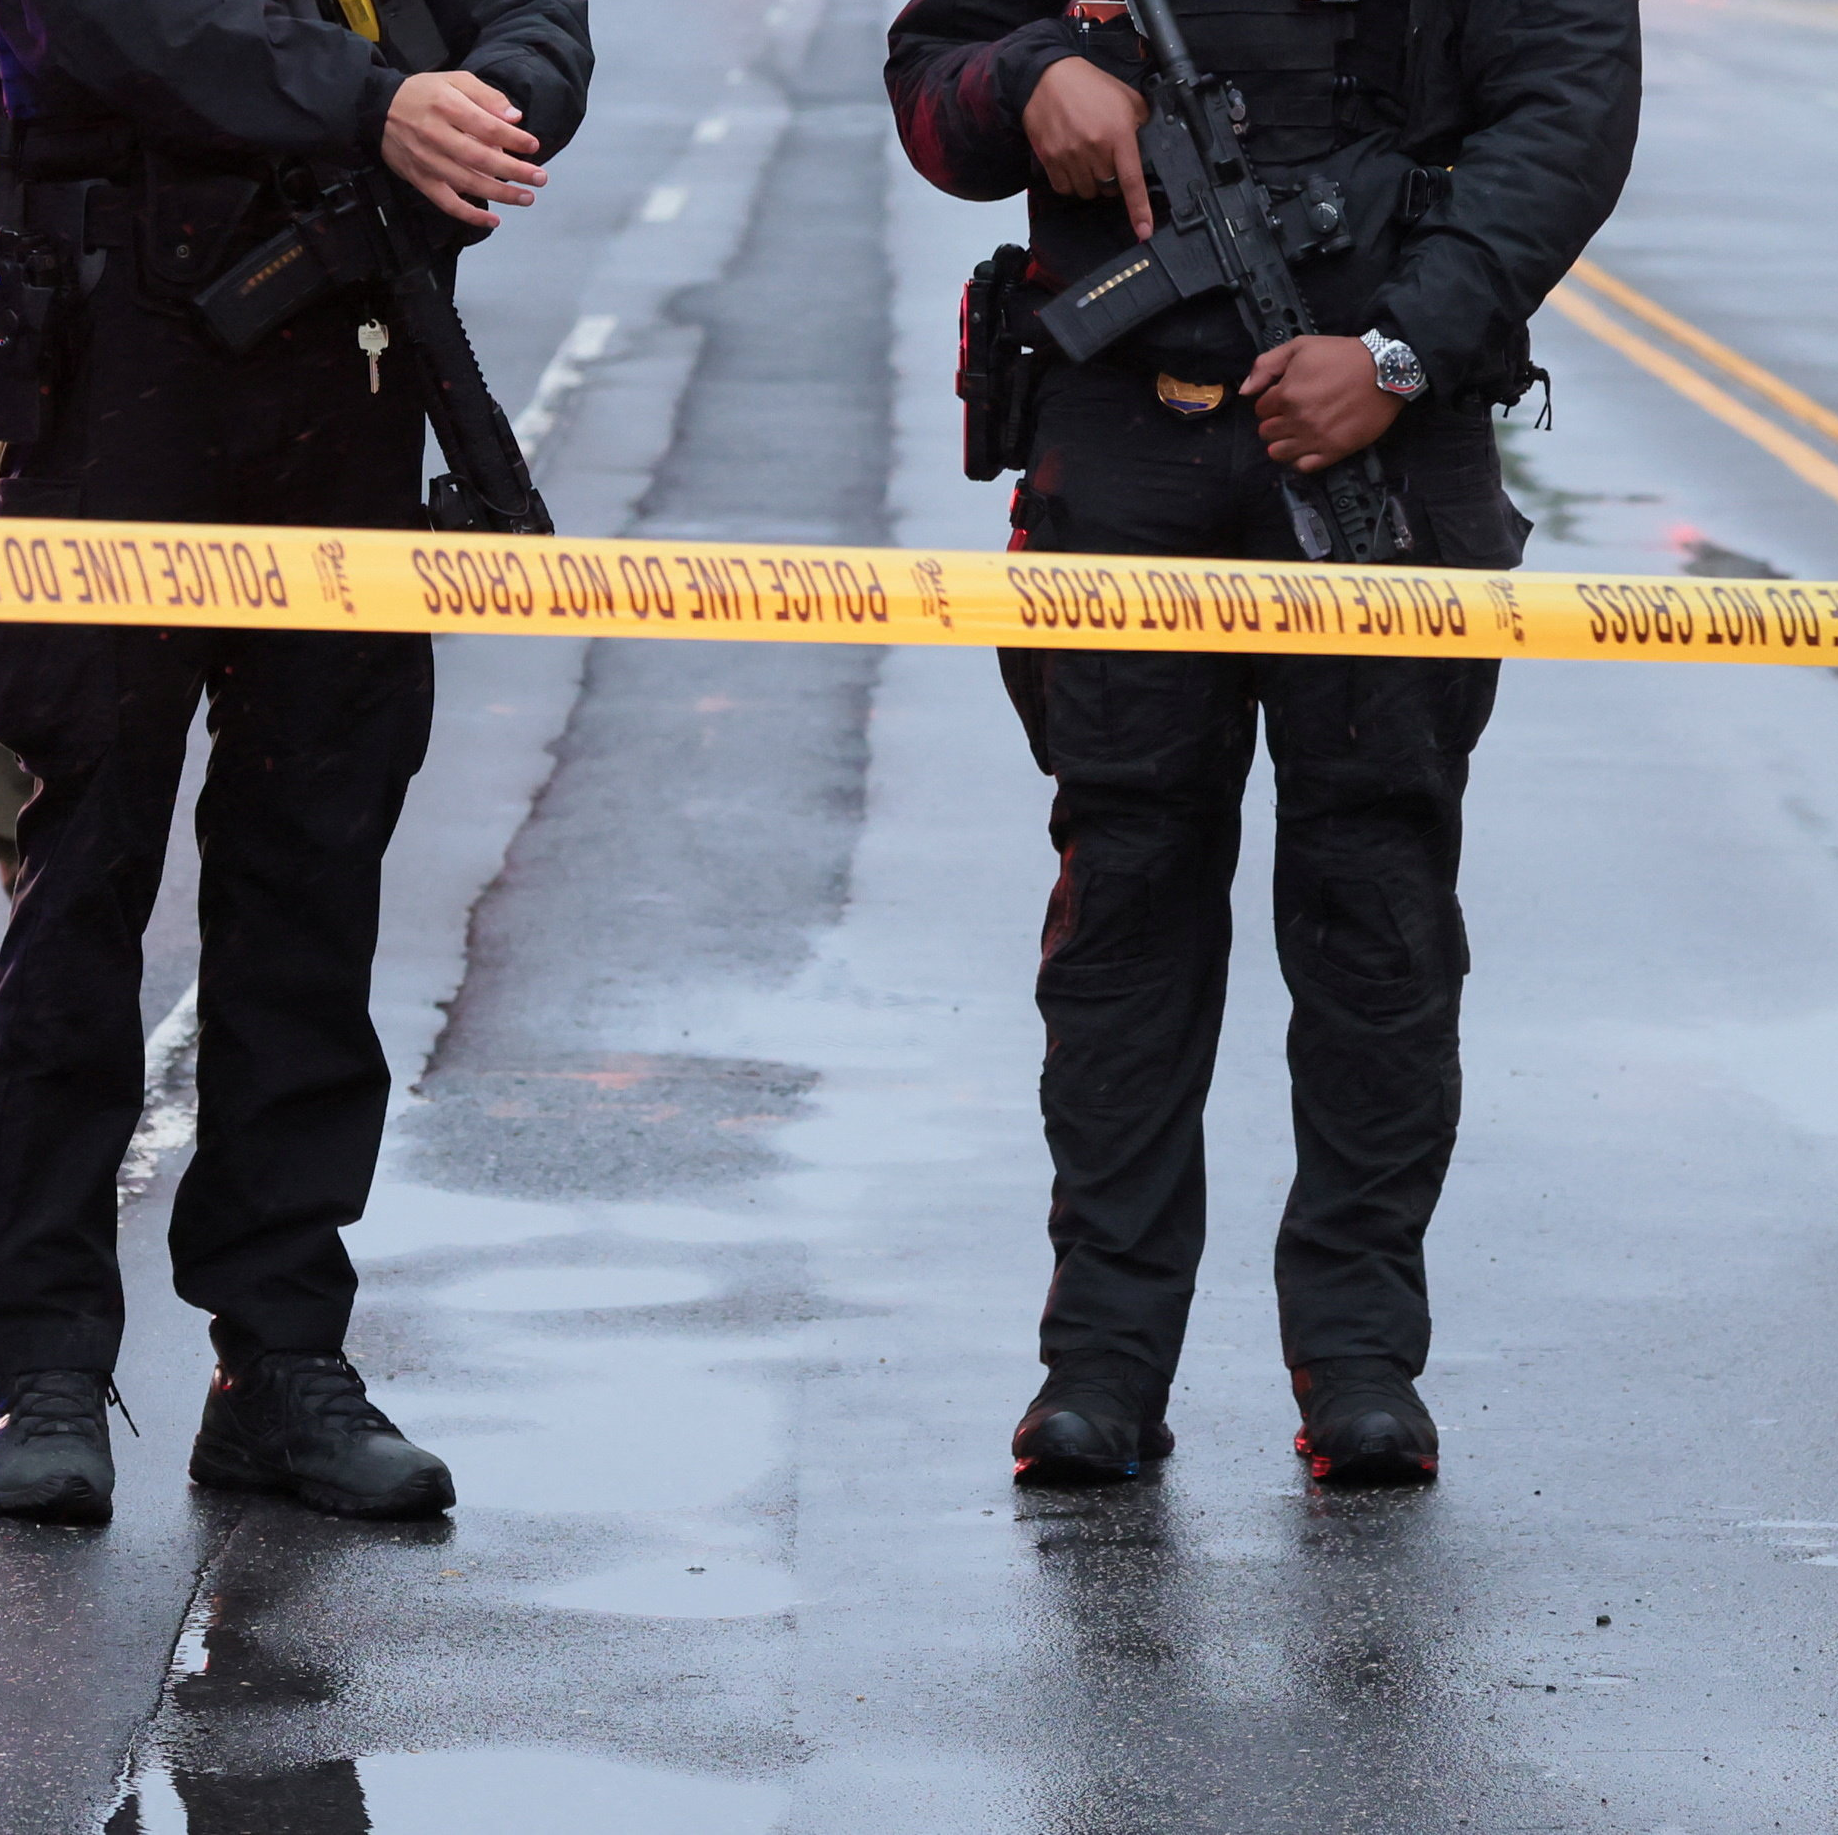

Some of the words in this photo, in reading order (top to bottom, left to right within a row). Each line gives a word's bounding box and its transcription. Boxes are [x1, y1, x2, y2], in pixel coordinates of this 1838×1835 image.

[3, 535, 63, 605] DO
[61, 538, 153, 605] LINE
[151, 539, 289, 610] POLICE
[410, 547, 535, 618] CROSS
[539, 552, 616, 620] NOT
[617, 554, 677, 622] DO
[673, 556, 763, 621] LINE
[758, 558, 890, 625] POLICE
[1006, 565, 1128, 632] CROSS
[1130, 569, 1205, 633] NOT
[1203, 571, 1262, 634] DO
[1258, 573, 1346, 635] LINE
[1341, 576, 1468, 639] POLICE
[1575, 582, 1695, 646] CROSS
[1695, 586, 1768, 647] NOT
[1765, 587, 1822, 649] DO
